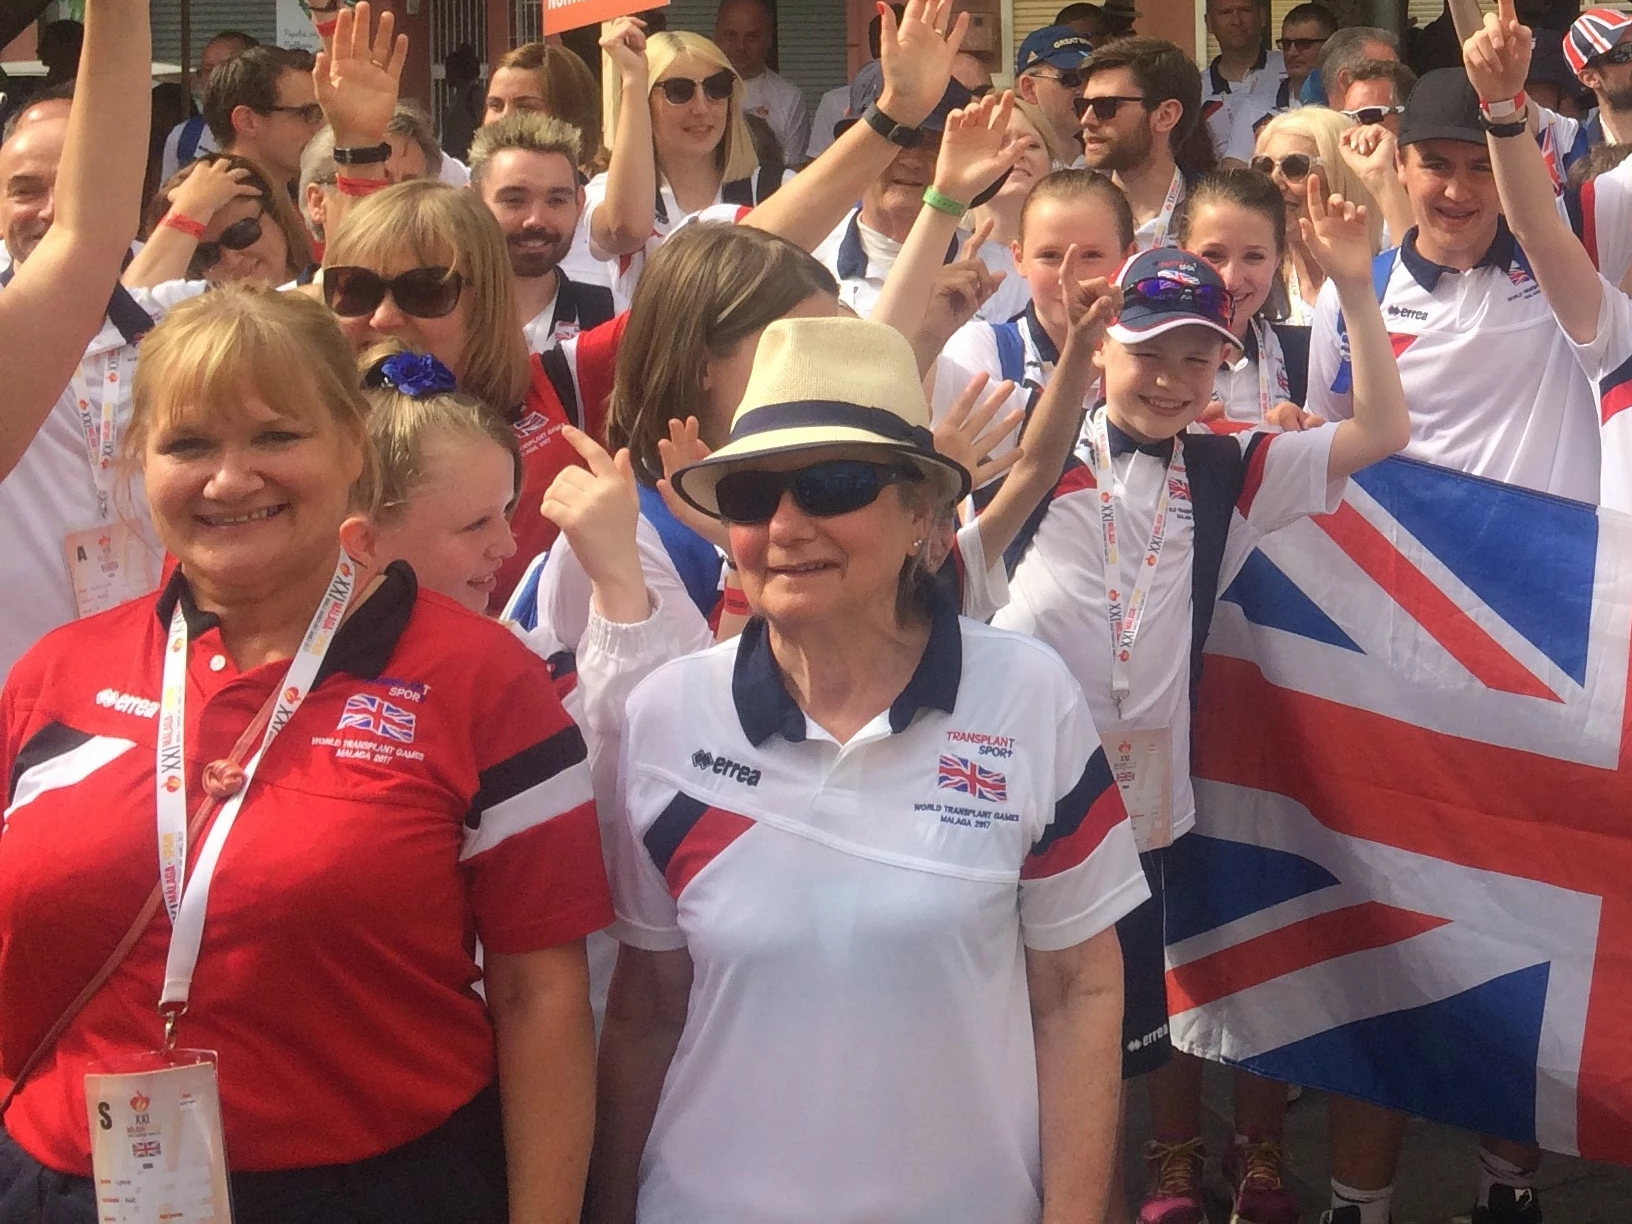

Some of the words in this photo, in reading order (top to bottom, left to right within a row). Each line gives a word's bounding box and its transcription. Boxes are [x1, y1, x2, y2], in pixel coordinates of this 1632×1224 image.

[1053, 37, 1080, 49] GREAT
[1400, 306, 1429, 321] errea
[1101, 504, 1114, 522] XXI
[76, 545, 87, 563] A
[1148, 535, 1163, 554] XXI
[328, 575, 351, 603] XXI
[1109, 602, 1121, 621] XXI
[1119, 630, 1135, 648] XXI
[114, 693, 161, 719] errea
[311, 736, 341, 747] WORLD
[343, 739, 396, 755] TRANSPLANT
[396, 749, 425, 761] GAMES
[946, 731, 1015, 748] TRANSPLANT
[161, 744, 181, 774] XXI
[335, 748, 371, 761] MALAGA
[712, 756, 762, 787] errea
[914, 803, 942, 812] WORLD
[944, 805, 993, 819] TRANSPLANT
[993, 812, 1019, 822] GAMES
[940, 815, 971, 827] MALAGA
[1142, 1022, 1169, 1047] errea
[97, 1102, 113, 1130] S
[135, 1113, 151, 1125] XXI
